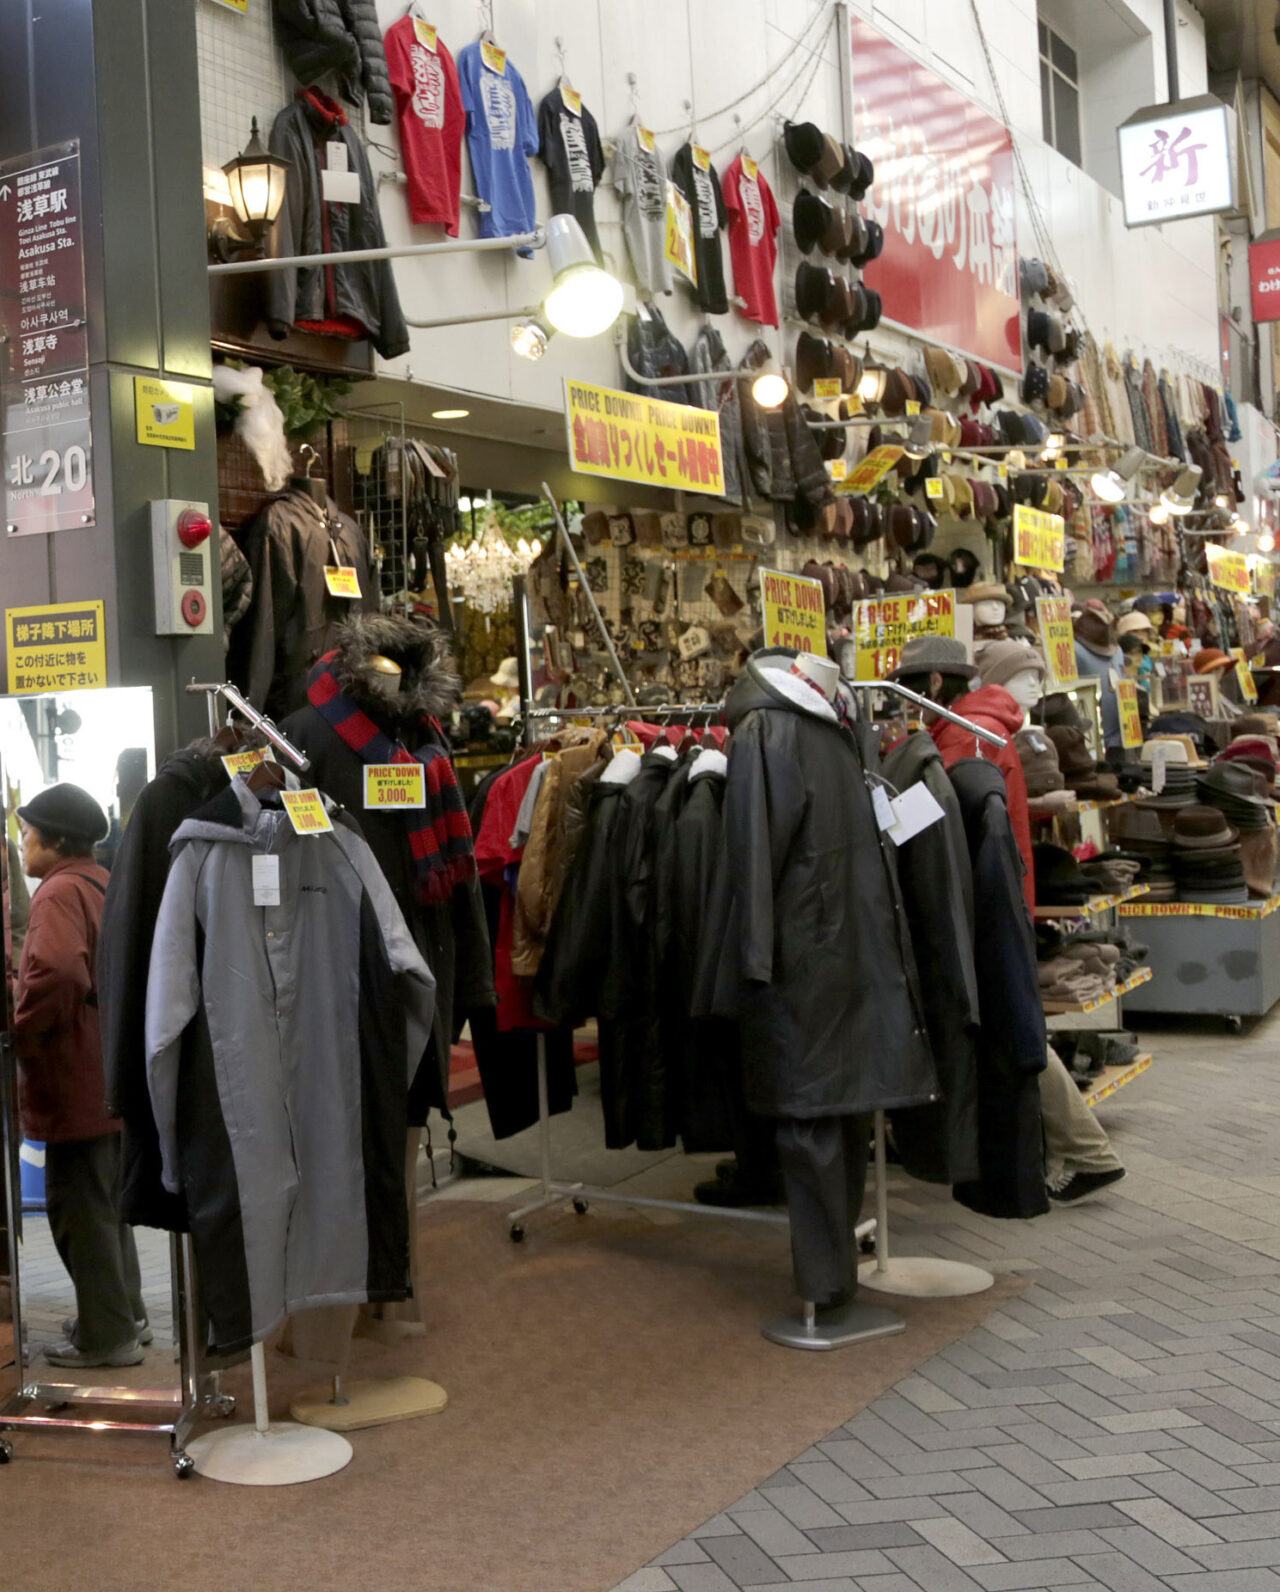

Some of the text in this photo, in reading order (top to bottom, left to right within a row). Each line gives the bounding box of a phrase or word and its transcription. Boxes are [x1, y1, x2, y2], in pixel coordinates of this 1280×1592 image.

[1139, 126, 1208, 187] 新
[17, 188, 67, 222] 浅草駅
[32, 231, 55, 242] Asakusa
[18, 238, 75, 259] Asakusa Sta.
[21, 308, 68, 329] 아사쿠사역
[22, 334, 58, 356] 浅草寺
[24, 378, 83, 404] 浅草公会堂
[571, 386, 601, 413] PRICE
[648, 405, 677, 429] PRICE
[11, 445, 87, 496] 北 20
[765, 576, 823, 615] PRICE DOWN
[16, 618, 94, 642] 梯子降下場所
[16, 651, 86, 669] この付近に物を
[368, 767, 420, 778] PRICE DOWN
[1151, 904, 1189, 916] DOWN
[1215, 906, 1253, 919] PRICE
